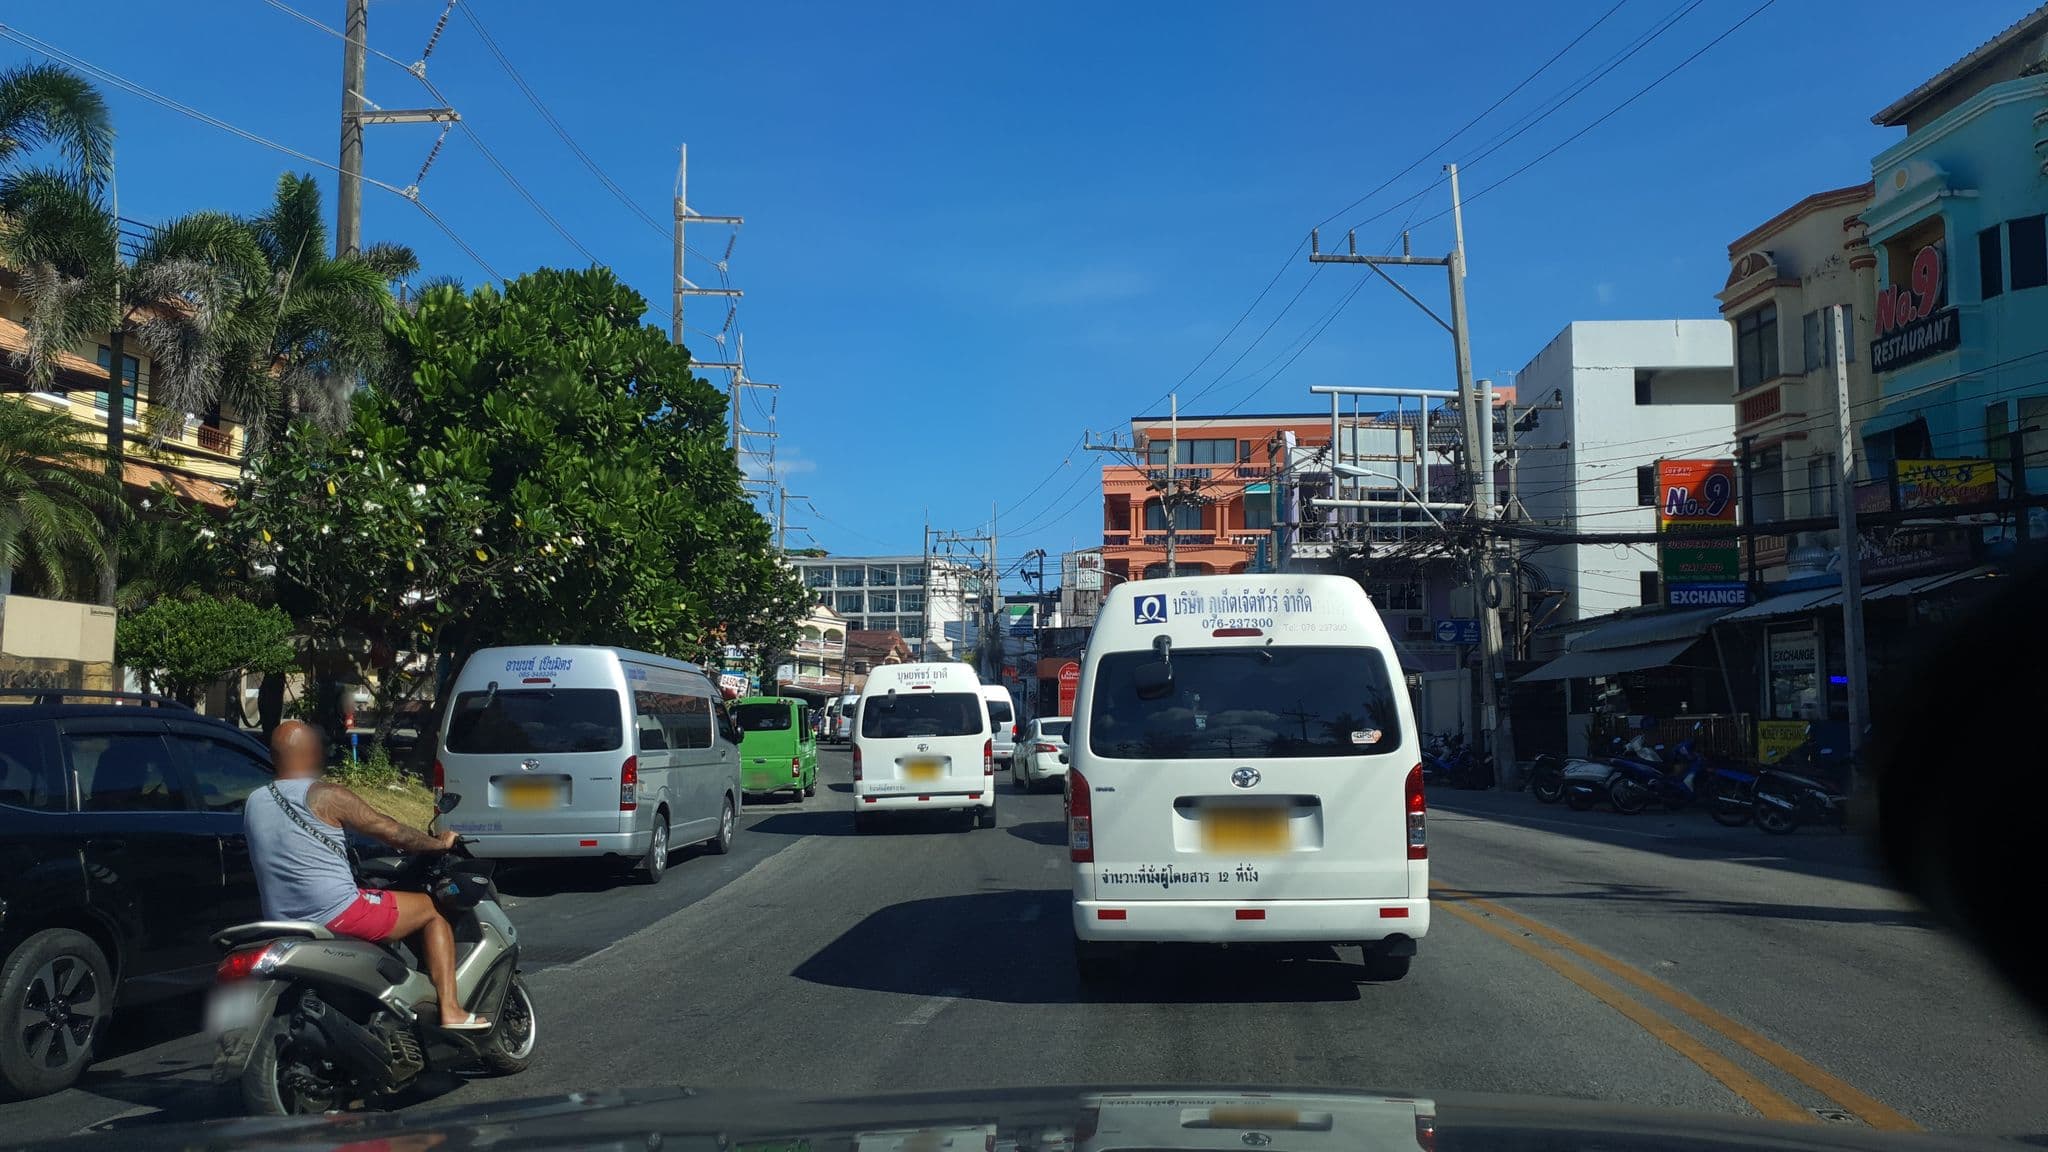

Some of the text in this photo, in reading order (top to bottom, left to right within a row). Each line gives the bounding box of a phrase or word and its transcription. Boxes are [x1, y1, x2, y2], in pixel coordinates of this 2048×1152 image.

[1873, 315, 1952, 367] RESTAURANT
[1173, 589, 1205, 615] บริษัท
[1282, 588, 1313, 615] จำกัด
[1670, 590, 1746, 604] EXCHANGE
[1202, 618, 1273, 629] 076-237300
[1773, 648, 1815, 662] EXCHANGE
[1218, 871, 1229, 883] 12
[1235, 863, 1259, 883] ที่นั่ง
